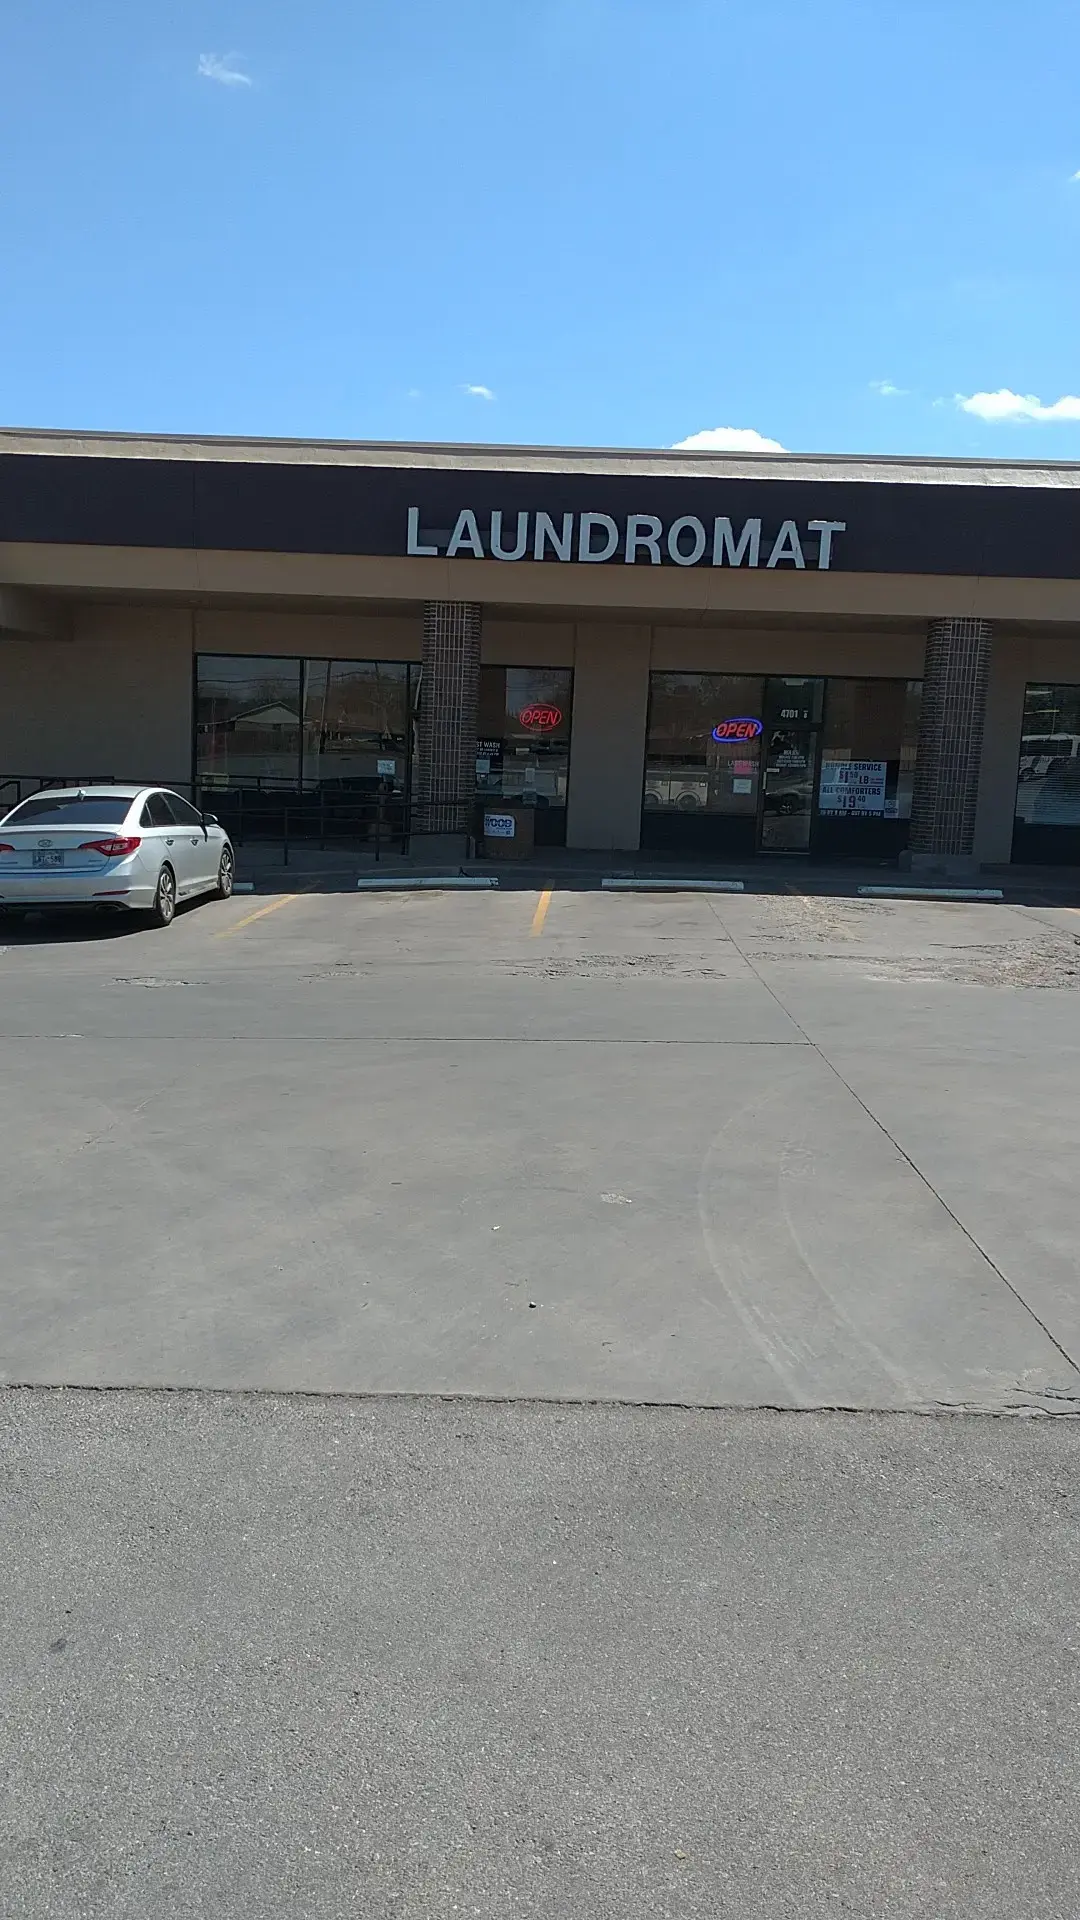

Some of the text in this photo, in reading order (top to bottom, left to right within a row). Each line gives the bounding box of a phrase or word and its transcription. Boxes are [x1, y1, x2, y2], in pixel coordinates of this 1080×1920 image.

[407, 506, 847, 570] LAUNDROMAT
[522, 710, 558, 725] OPEN
[780, 709, 799, 719] 4701
[716, 723, 756, 738] OPEN
[484, 741, 501, 749] WASH
[854, 763, 882, 771] SERVICE
[860, 776, 869, 784] LB
[836, 787, 881, 796] COMFORTERS
